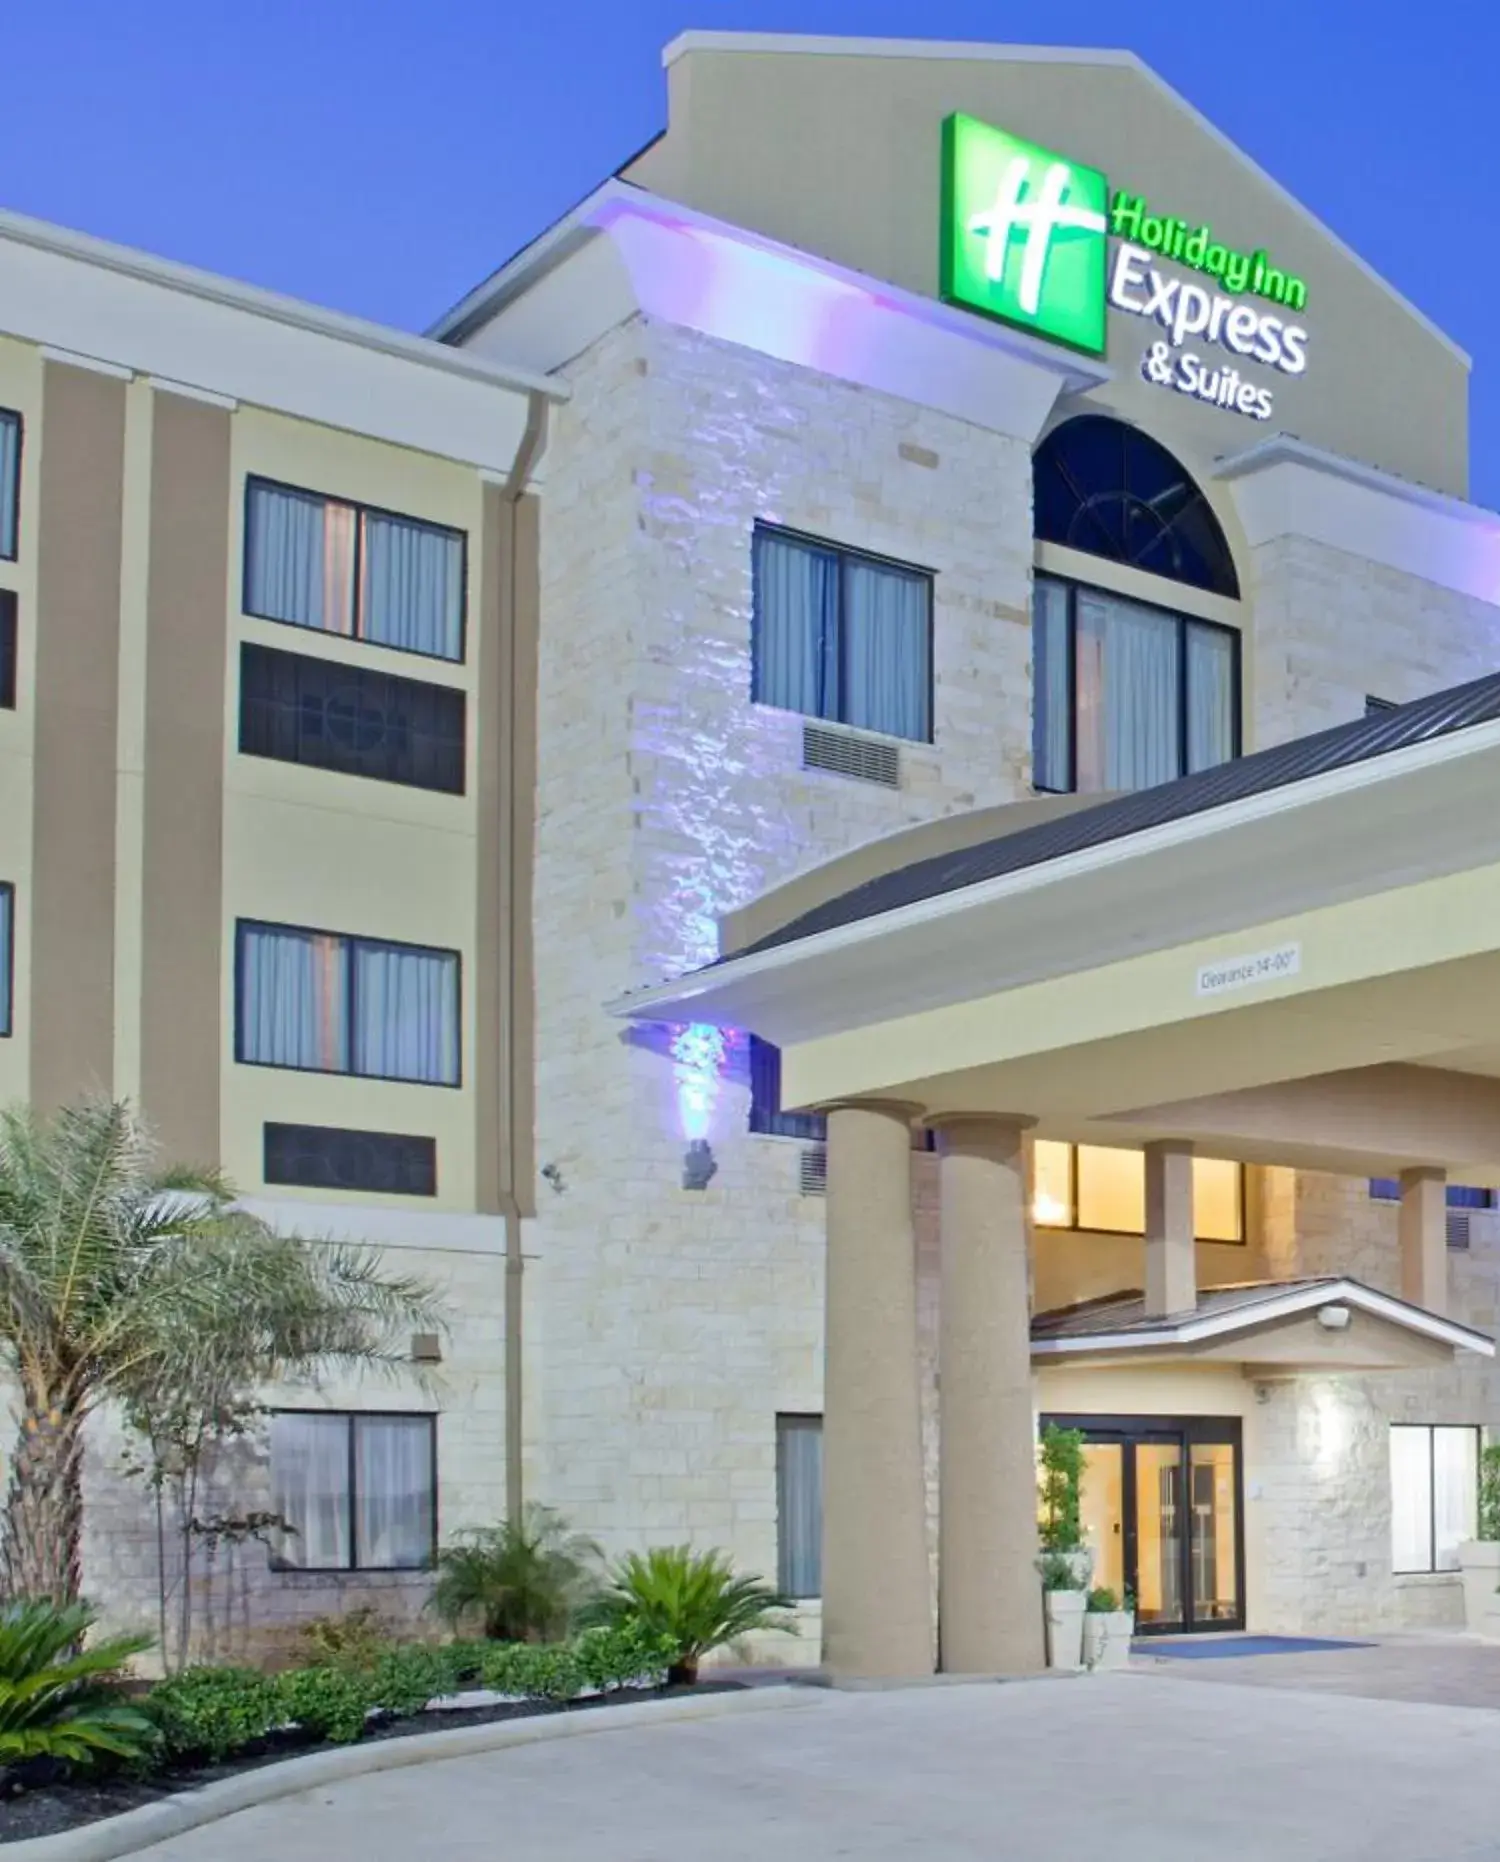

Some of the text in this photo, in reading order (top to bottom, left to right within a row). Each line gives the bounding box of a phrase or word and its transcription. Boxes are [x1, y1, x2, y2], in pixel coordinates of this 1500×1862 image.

[1109, 243, 1308, 373] Express
[1112, 190, 1307, 309] Holiday Inn
[1144, 341, 1273, 420] & Suites
